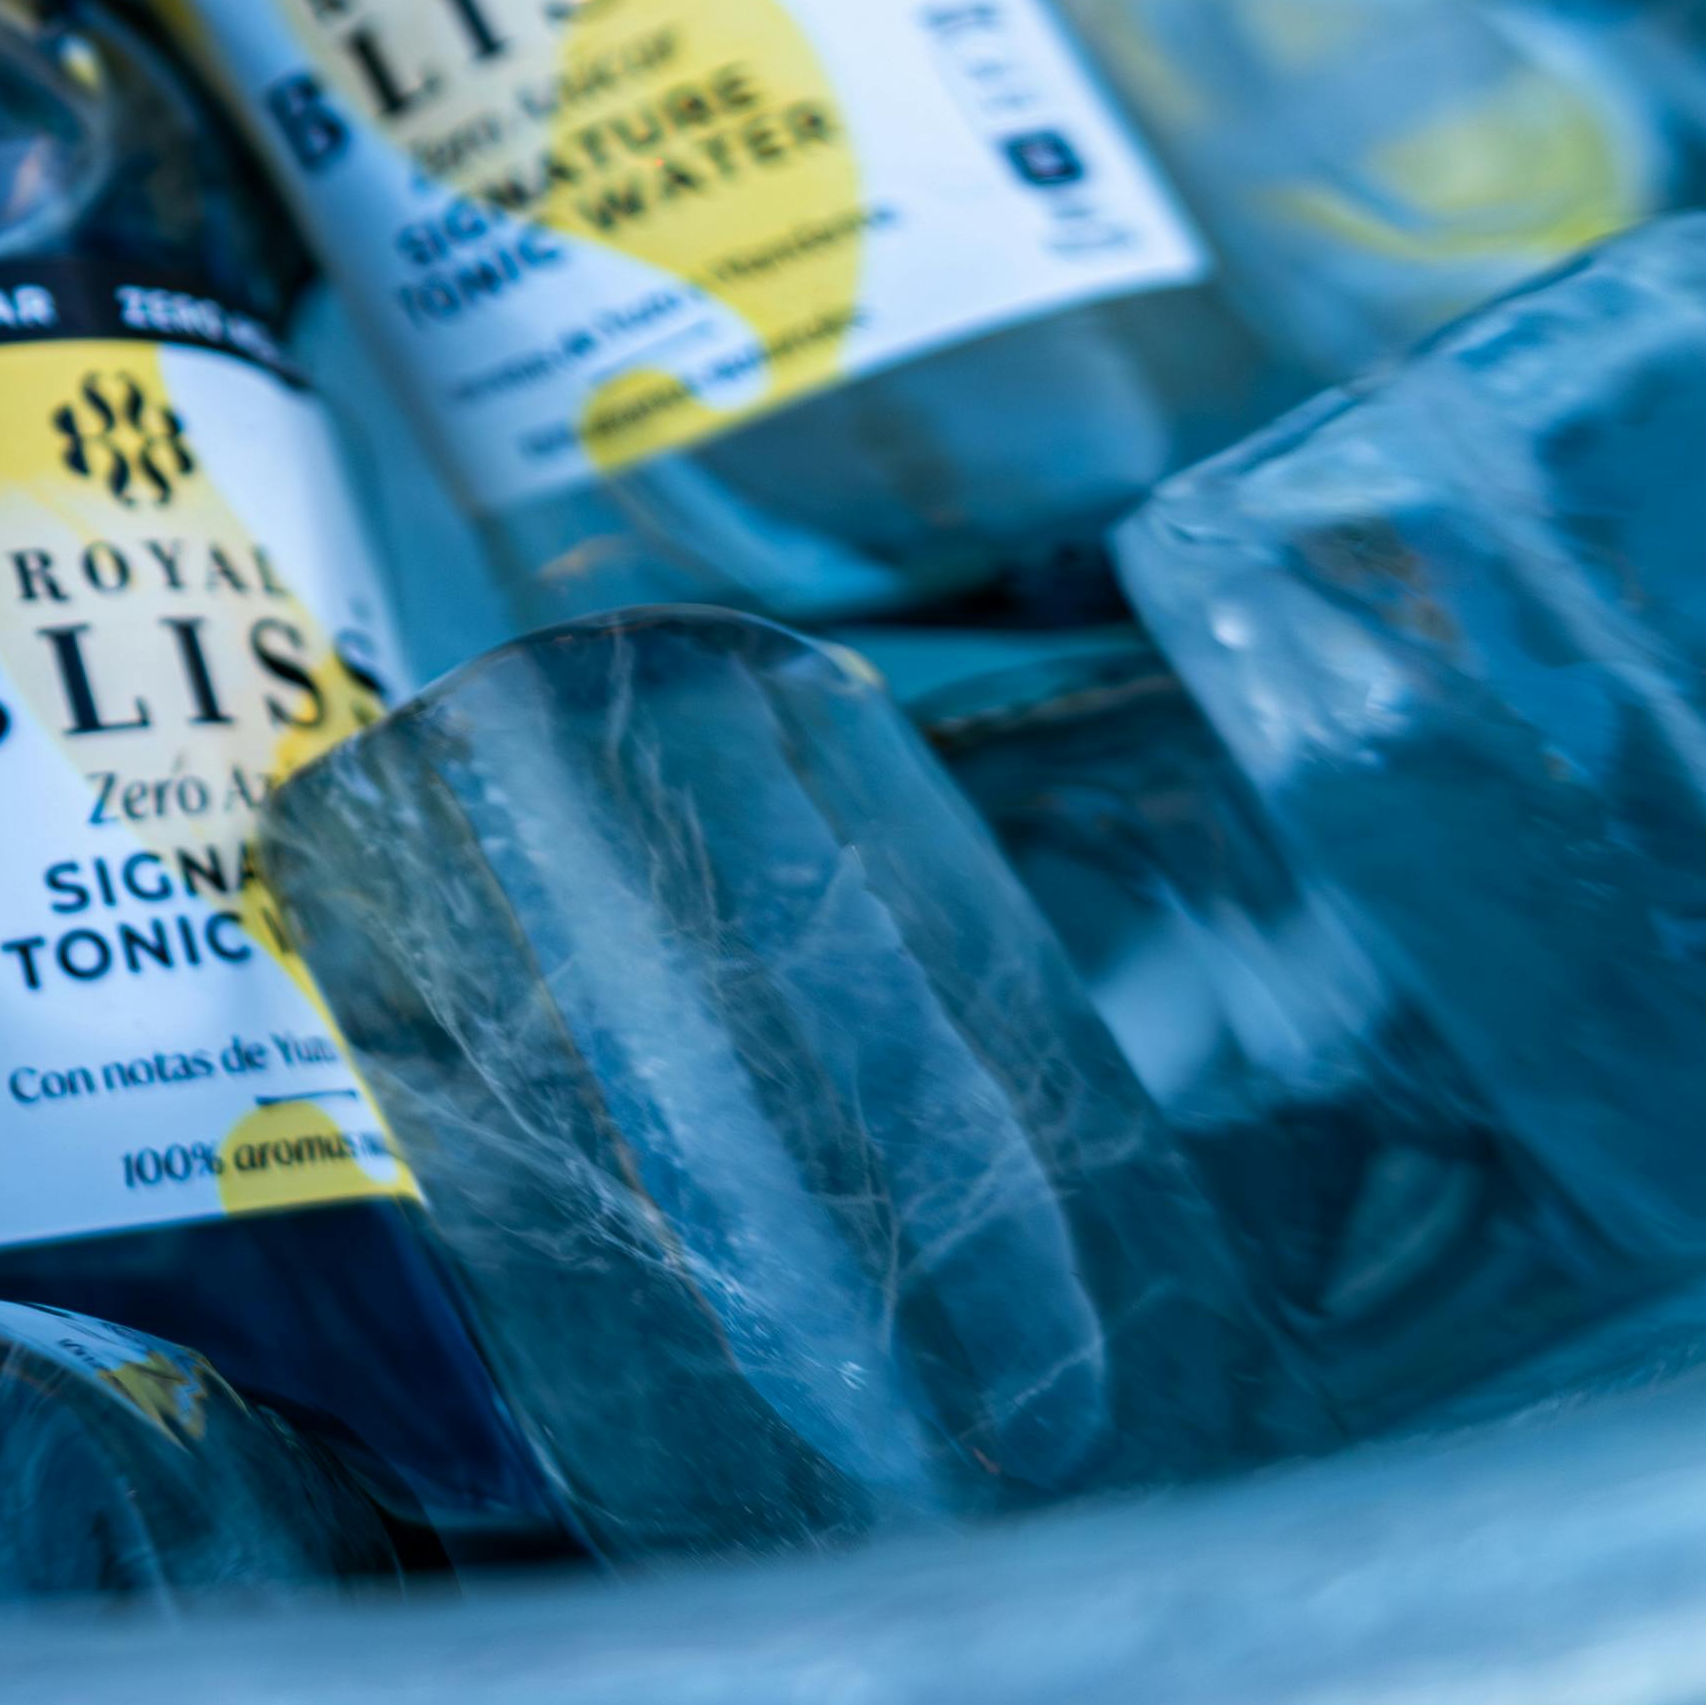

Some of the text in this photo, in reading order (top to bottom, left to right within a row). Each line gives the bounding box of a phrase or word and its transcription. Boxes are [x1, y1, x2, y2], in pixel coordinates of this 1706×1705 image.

[580, 97, 833, 234] WATER
[6, 538, 291, 608] ROYAL
[86, 768, 211, 829] Zero
[0, 909, 253, 993] TONIC
[7, 1064, 96, 1106] Con
[102, 1046, 216, 1091] notas
[220, 1032, 269, 1075] de
[120, 1138, 226, 1190] 100%
